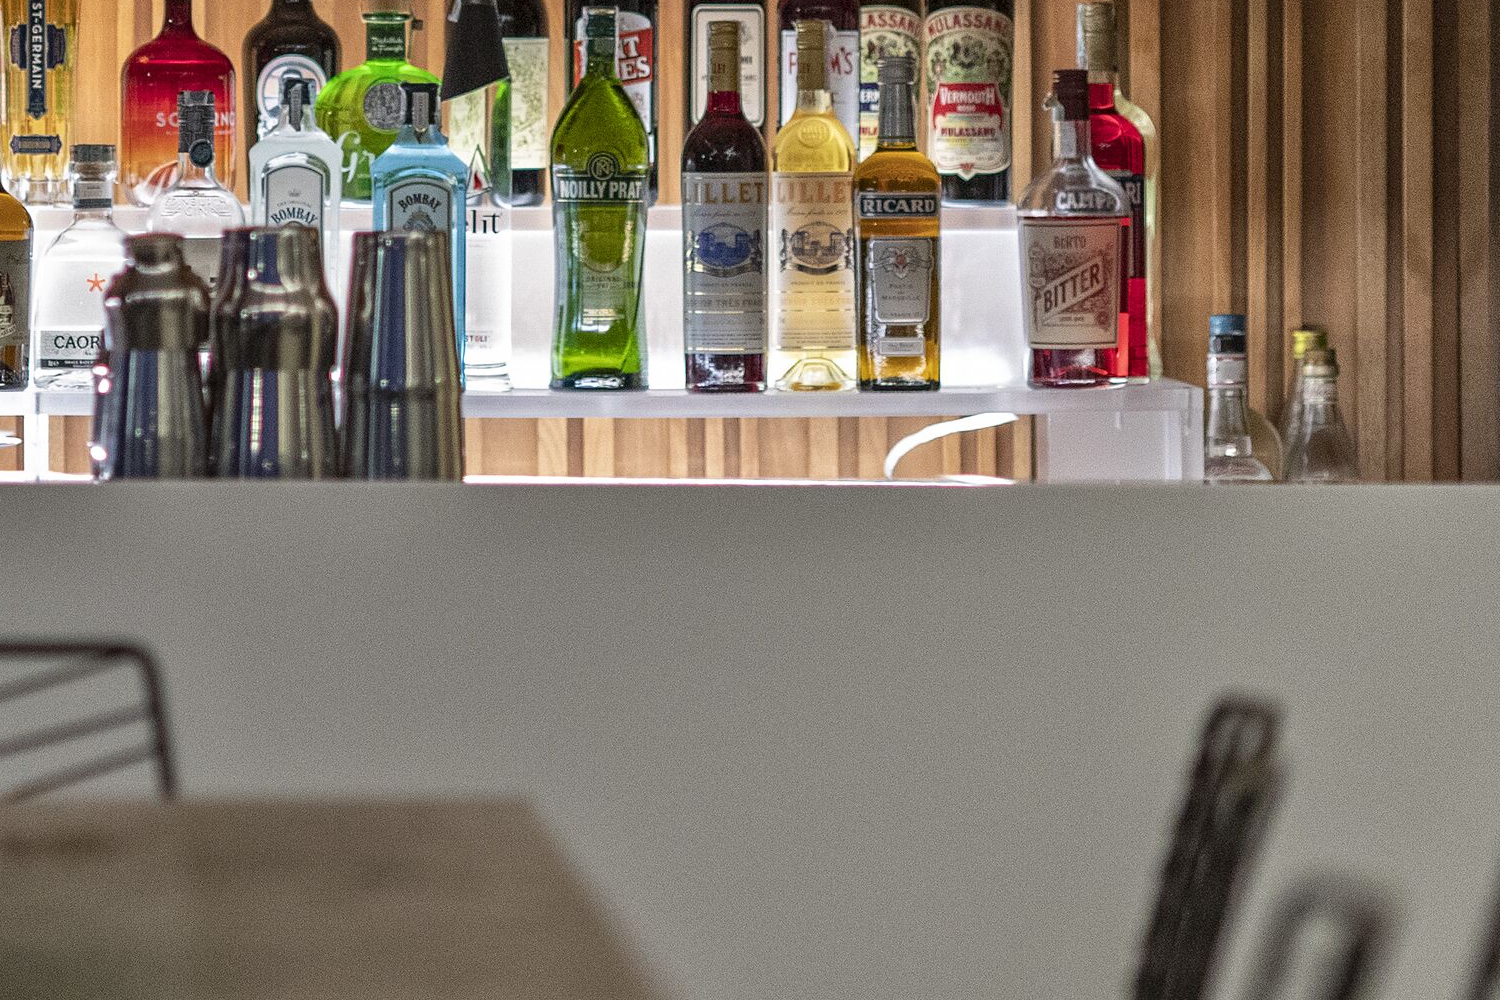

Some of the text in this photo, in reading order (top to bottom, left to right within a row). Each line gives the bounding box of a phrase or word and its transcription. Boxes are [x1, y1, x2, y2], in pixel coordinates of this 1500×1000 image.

[31, 2, 43, 89] ST-GERMAIN
[621, 57, 650, 79] ES
[940, 86, 996, 105] VERMOUTH
[560, 180, 643, 199] NOILLY PRAT
[397, 193, 442, 214] BOMBAY
[863, 198, 935, 214] RICARD
[270, 206, 318, 224] BOMBAY
[466, 209, 501, 234] lit
[1043, 264, 1100, 313] BITTER
[53, 335, 100, 349] CAOR
